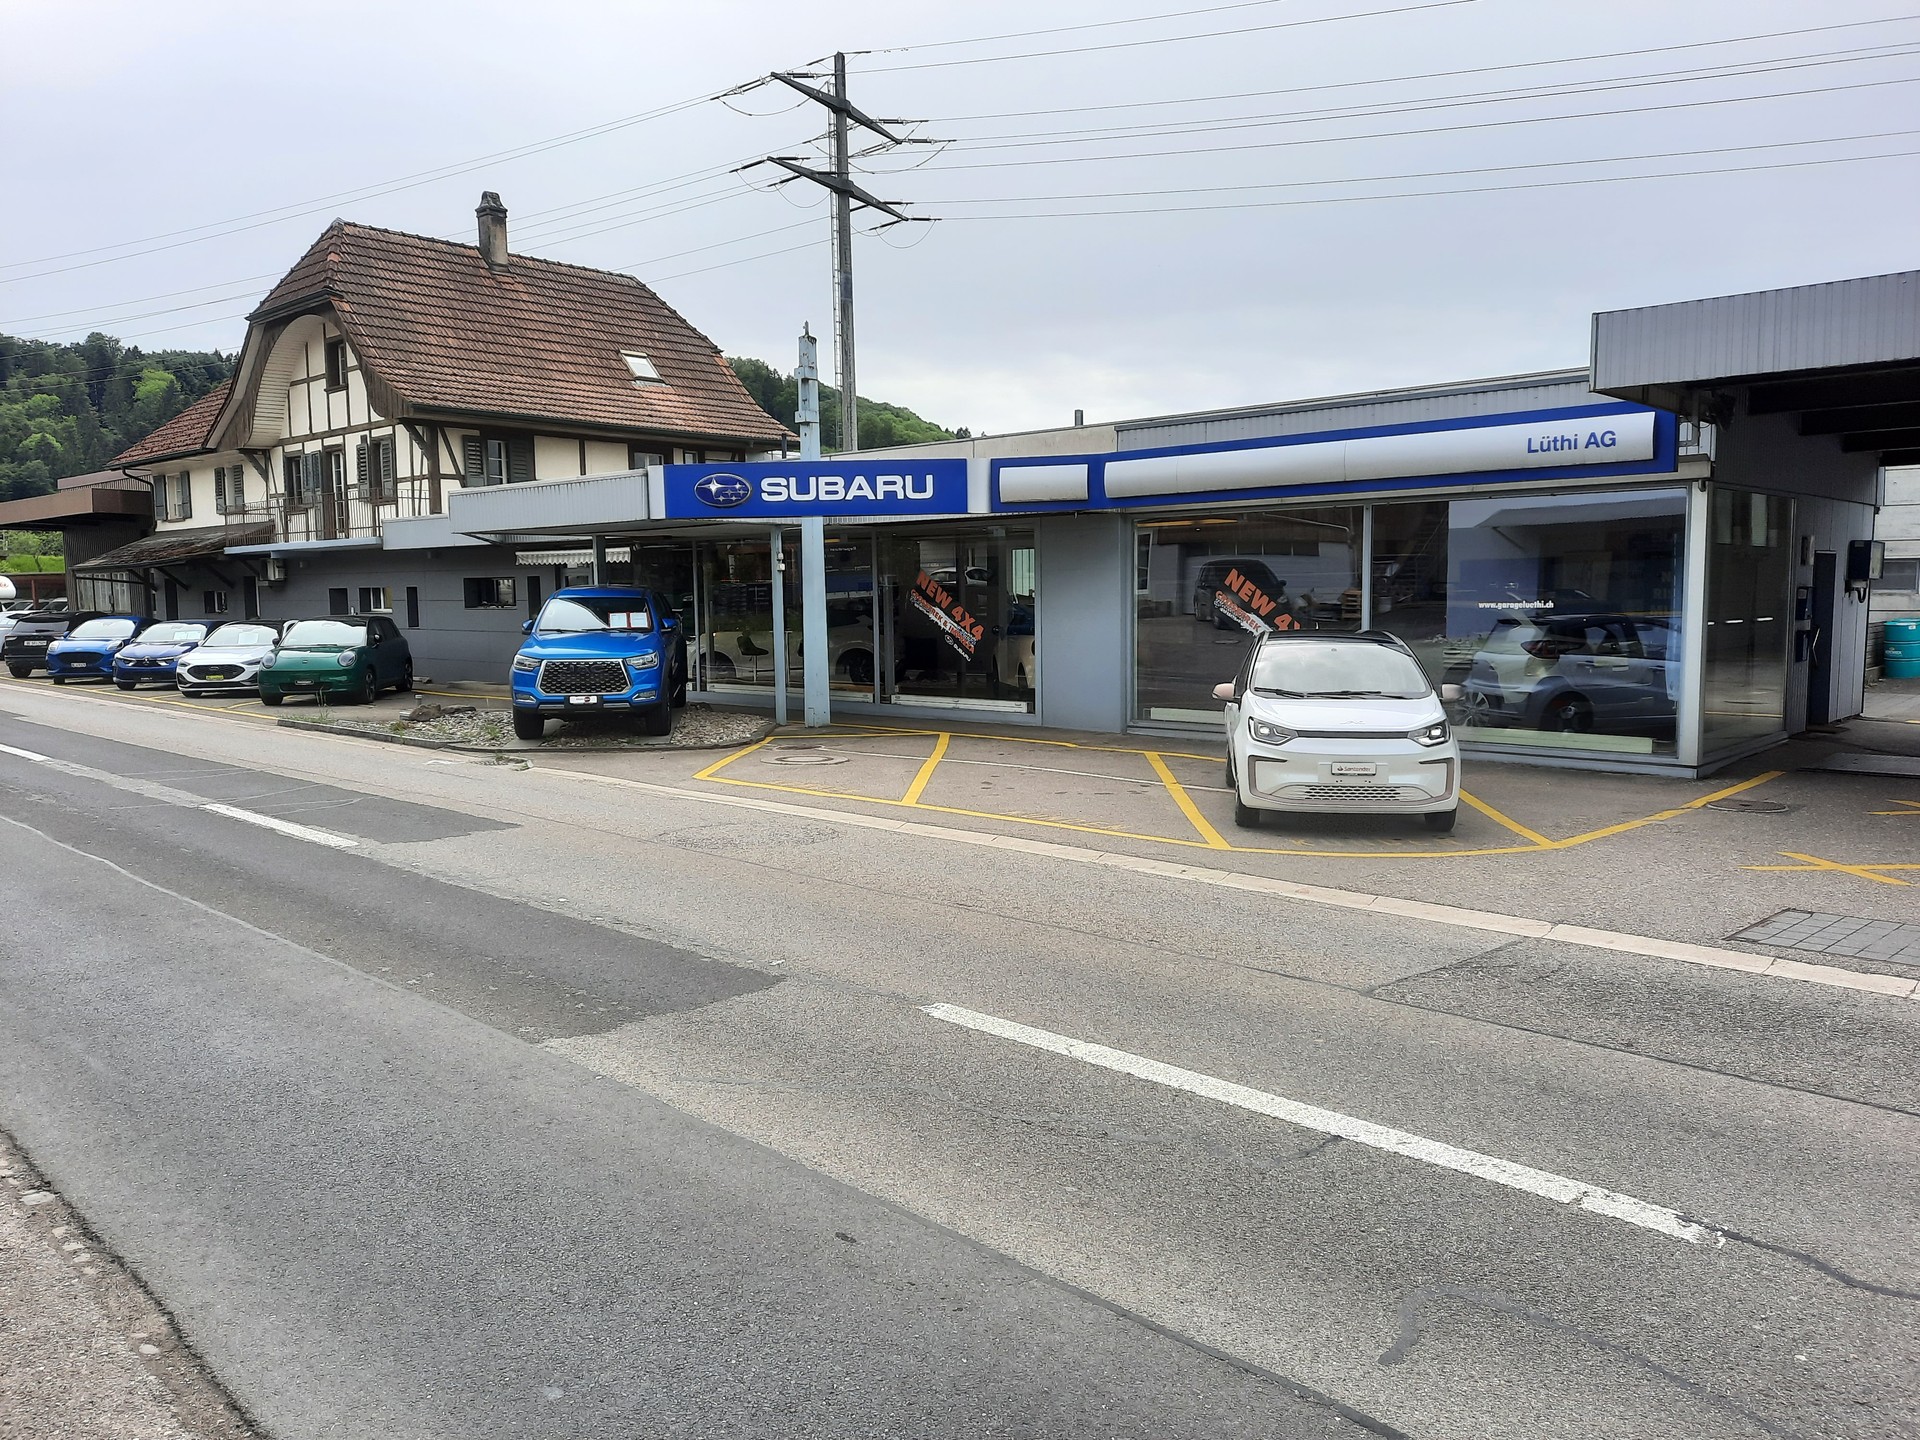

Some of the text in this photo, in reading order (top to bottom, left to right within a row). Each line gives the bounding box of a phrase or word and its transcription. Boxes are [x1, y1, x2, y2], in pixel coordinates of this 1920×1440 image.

[1527, 430, 1616, 454] Lüthi AG
[760, 474, 934, 501] SUBARU
[1224, 568, 1277, 617] NEW
[1478, 600, 1554, 610] www.garageluethi.ch
[916, 570, 985, 641] NEW 4X4
[953, 643, 972, 662] SUBARU
